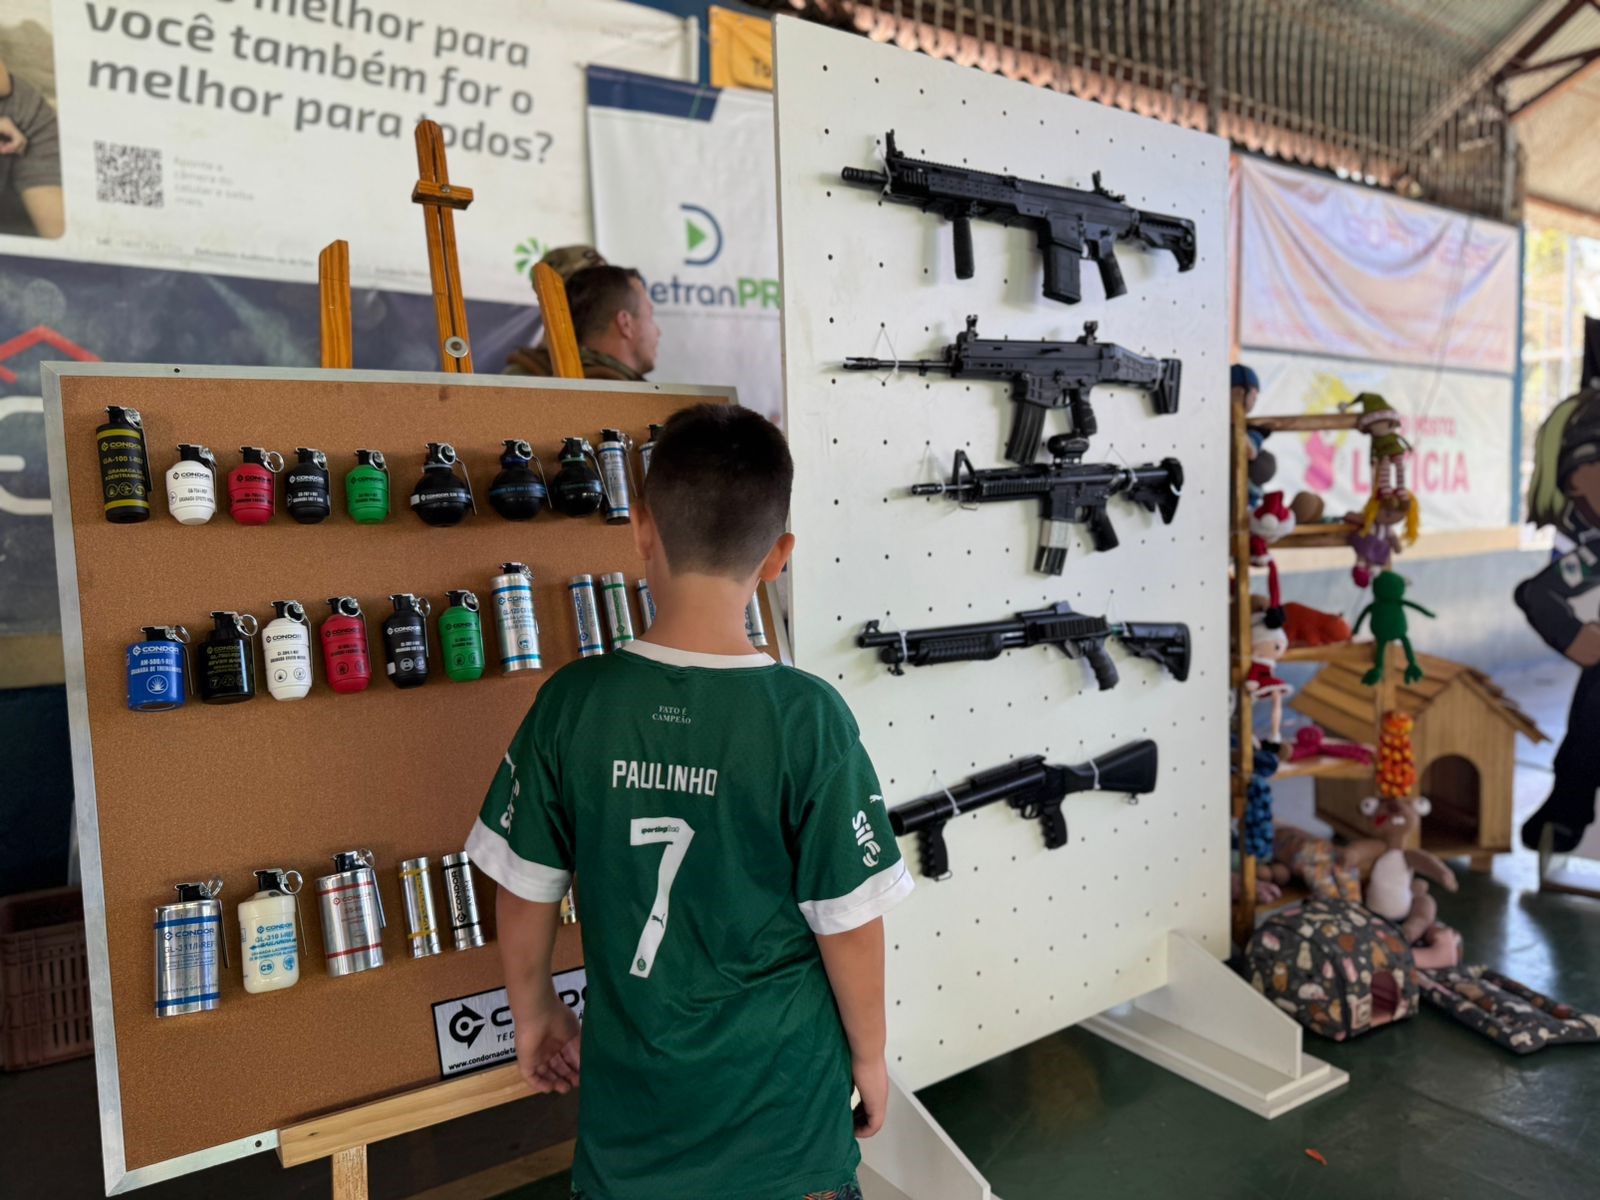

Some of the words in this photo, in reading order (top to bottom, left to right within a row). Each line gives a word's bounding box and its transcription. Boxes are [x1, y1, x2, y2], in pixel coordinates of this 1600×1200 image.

[86, 2, 215, 52] você
[230, 25, 427, 94] também
[434, 66, 501, 107] for
[511, 89, 533, 114] o
[434, 25, 529, 67] para
[89, 59, 283, 117] melhor
[294, 97, 402, 139] para
[415, 113, 554, 164] odos?
[640, 275, 780, 309] etranPR
[651, 712, 692, 724] CAMPEÃO
[659, 705, 681, 715] FATO
[611, 759, 719, 797] PAULINHO
[451, 870, 462, 911] CONDOR
[629, 816, 696, 979] 7
[174, 927, 215, 938] CONDOR
[265, 922, 292, 931] CONDOR
